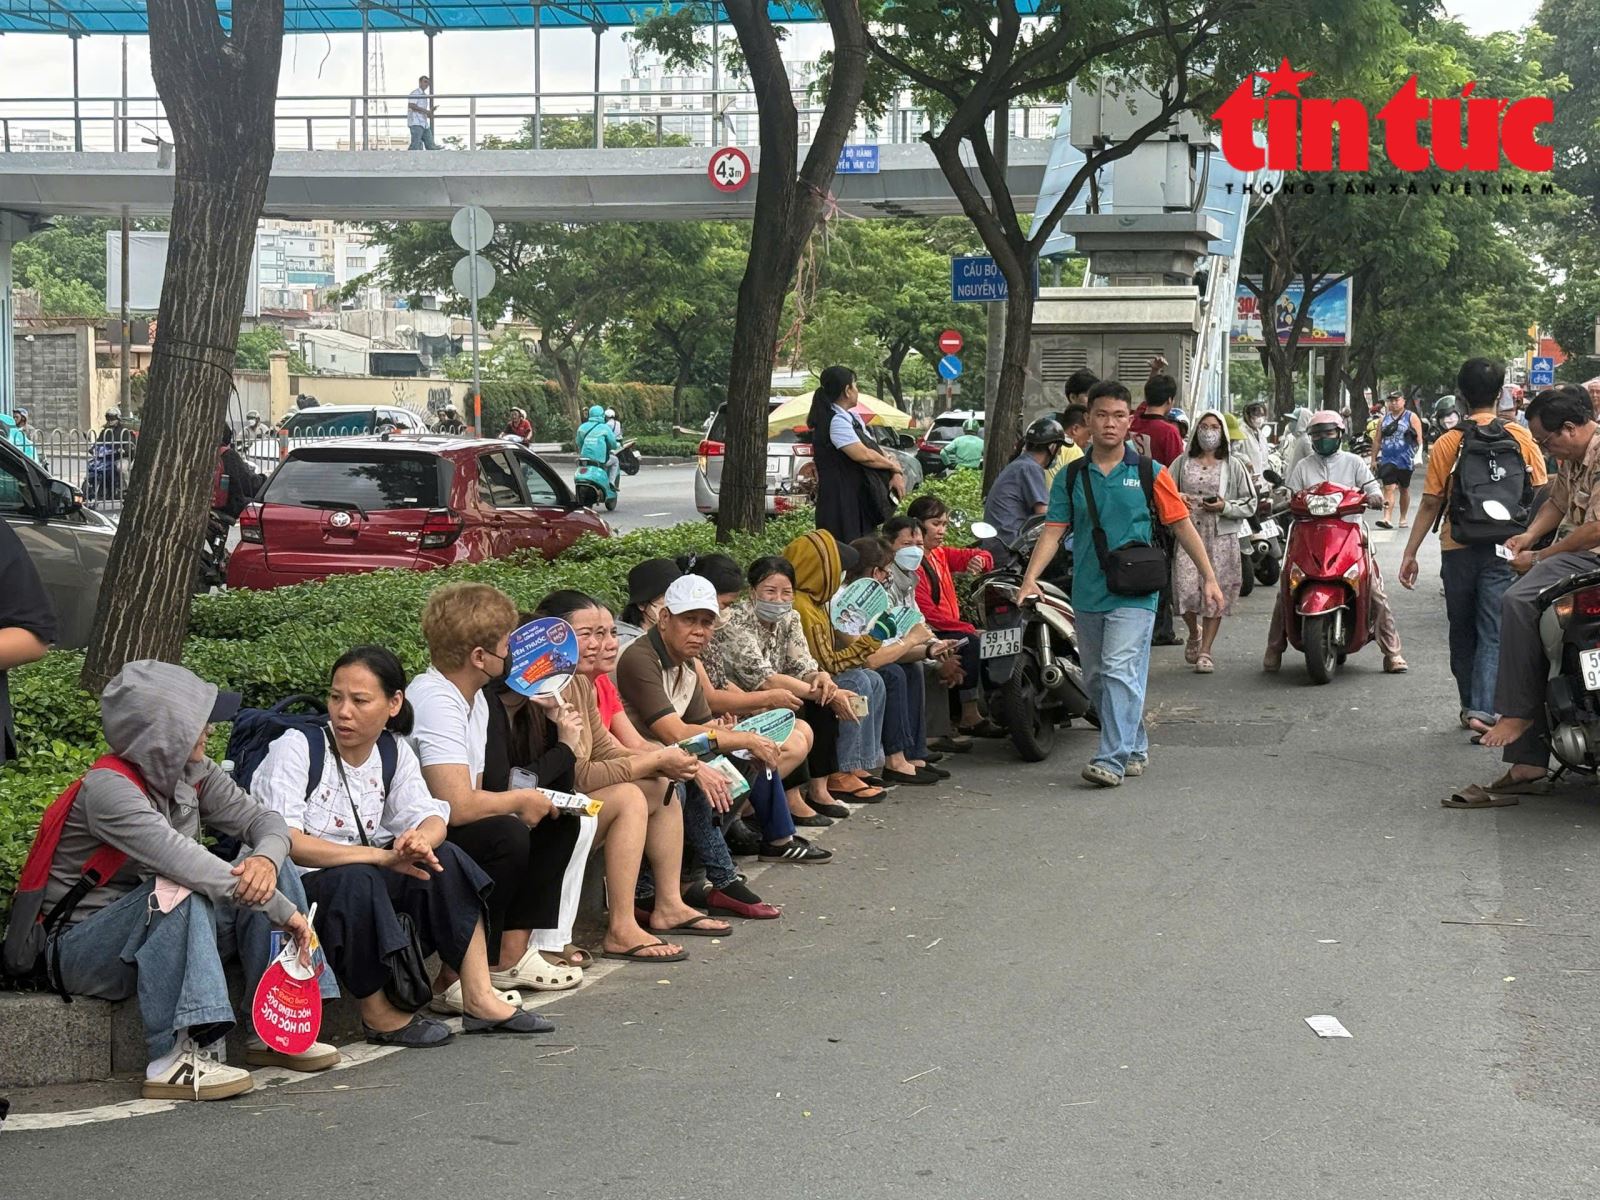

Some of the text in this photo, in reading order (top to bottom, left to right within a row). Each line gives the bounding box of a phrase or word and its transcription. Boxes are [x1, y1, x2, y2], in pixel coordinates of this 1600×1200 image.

[1122, 478, 1140, 488] UEH
[982, 641, 1019, 657] 172.36
[298, 1007, 312, 1018] HỌC
[278, 1017, 297, 1033] HỌC
[298, 1021, 311, 1034] DU
